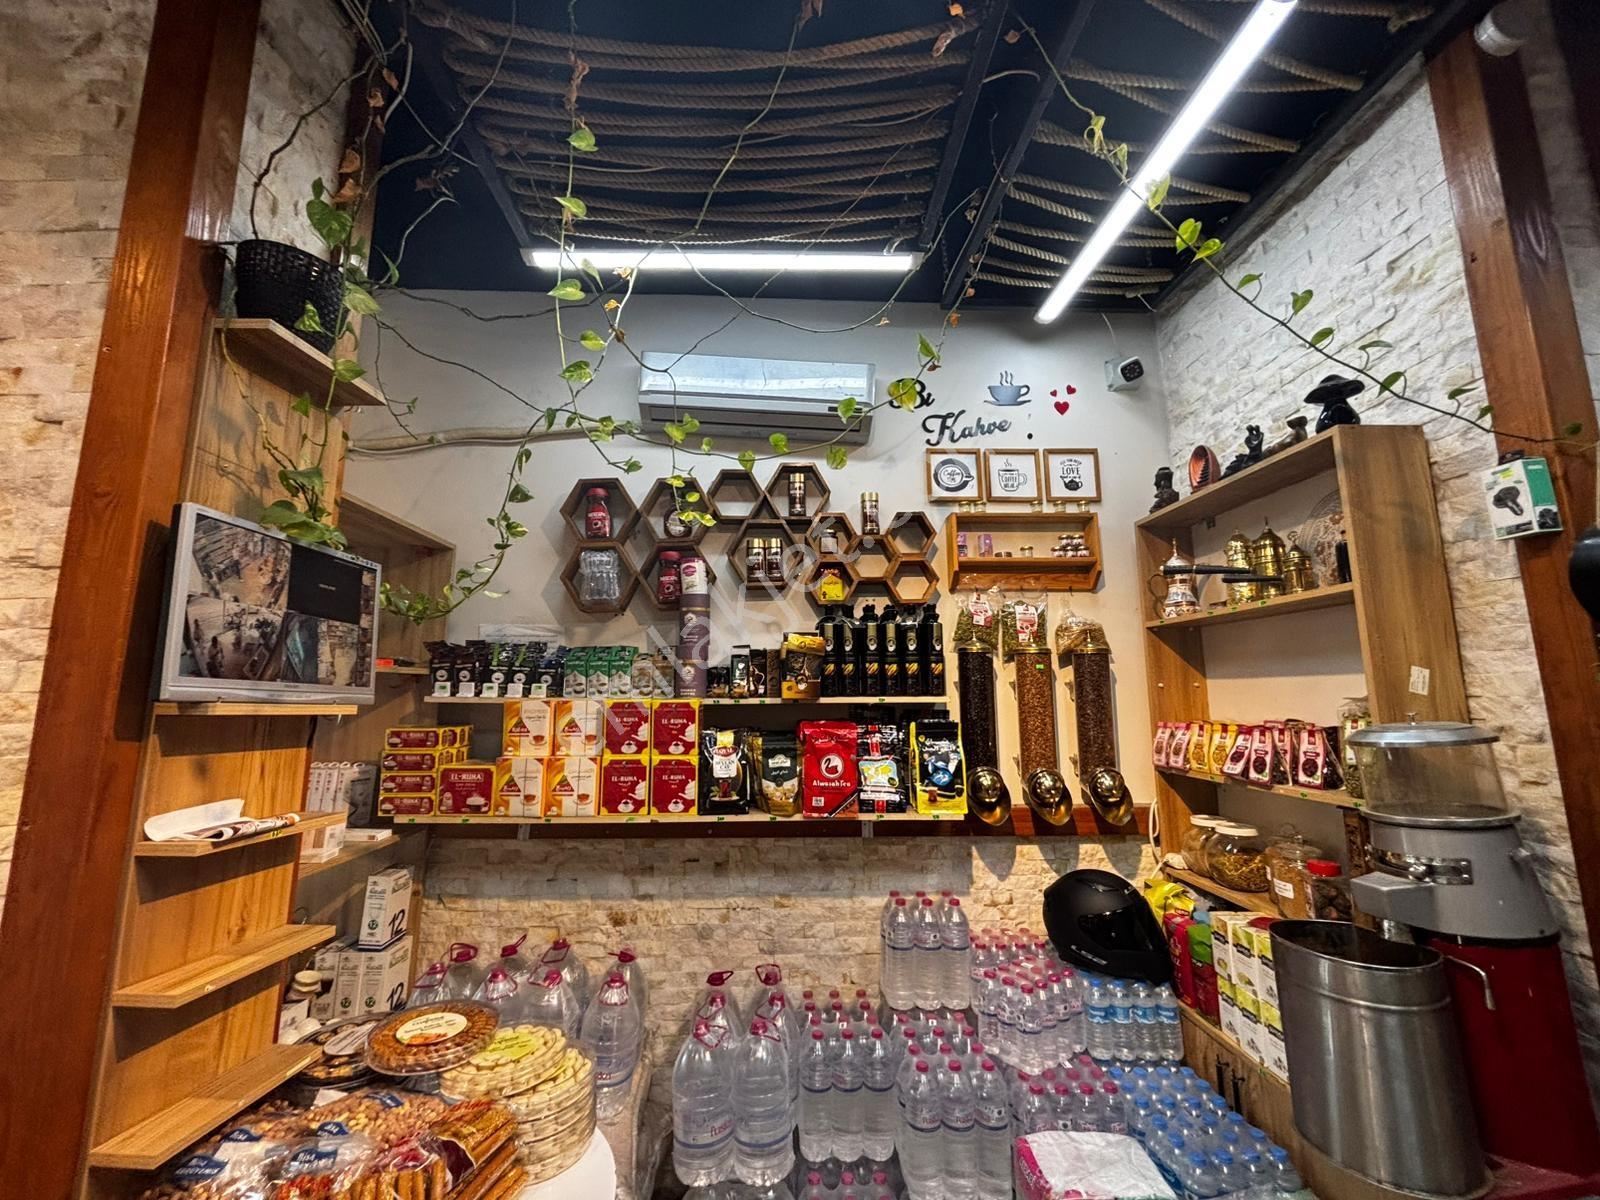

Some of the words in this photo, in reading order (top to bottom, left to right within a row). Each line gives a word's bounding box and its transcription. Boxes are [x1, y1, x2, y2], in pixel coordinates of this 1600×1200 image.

[921, 409, 1011, 446] Kahve
[1061, 467, 1081, 476] LOVE
[388, 908, 406, 939] 12
